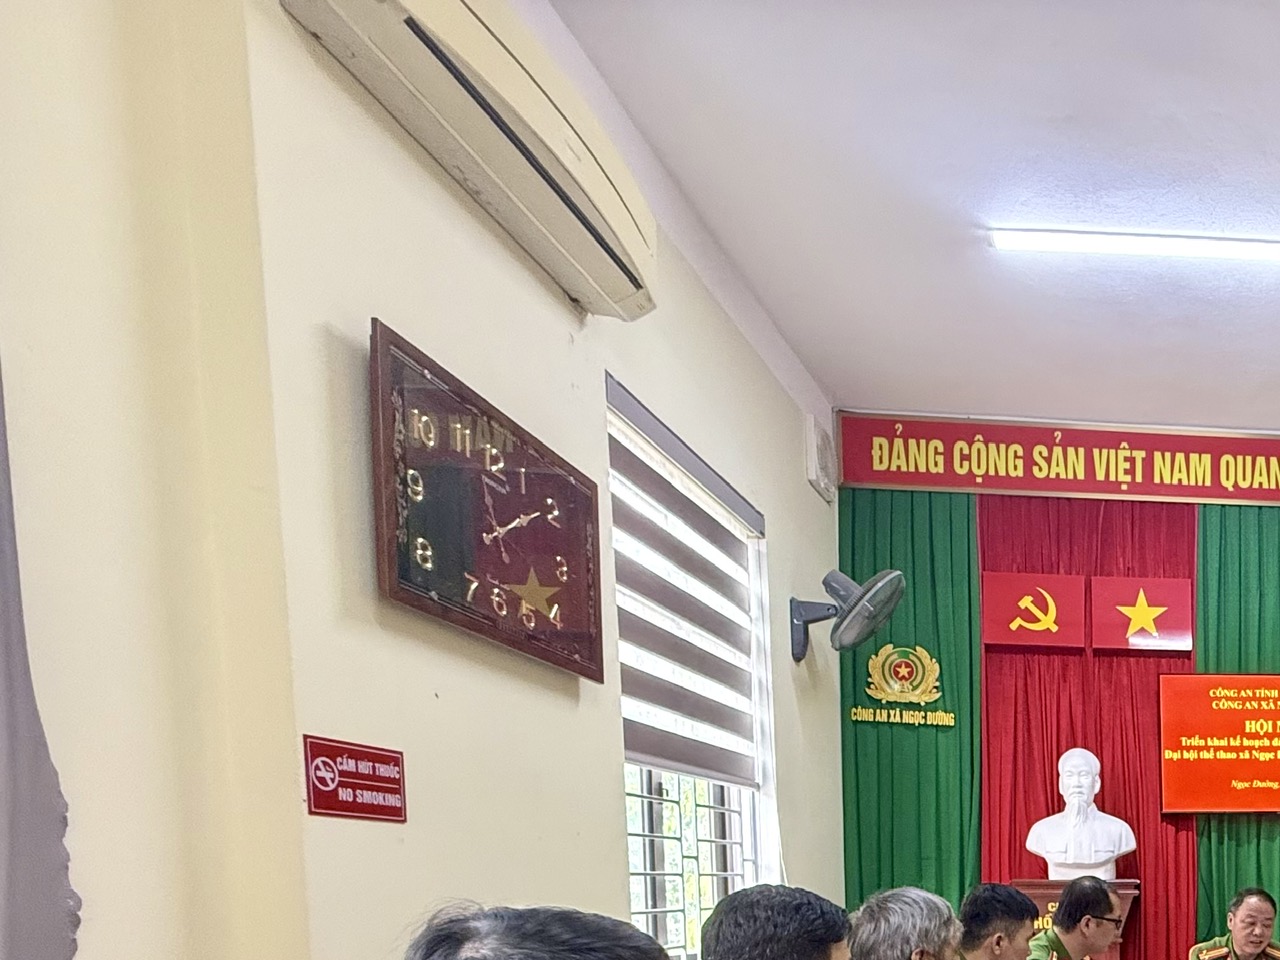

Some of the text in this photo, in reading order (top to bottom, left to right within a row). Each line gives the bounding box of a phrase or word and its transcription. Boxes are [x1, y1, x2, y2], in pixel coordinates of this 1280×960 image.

[872, 423, 944, 474] ĐẢNG
[953, 434, 1024, 483] CỘNG
[1032, 431, 1085, 480] SẢN
[1092, 442, 1146, 490] VIỆT
[1153, 450, 1212, 486] NAM
[1209, 686, 1238, 698] CÔNG
[1239, 689, 1253, 698] AN
[1254, 687, 1279, 698] TỈNH
[1212, 698, 1242, 710] CÔNG
[1244, 701, 1258, 710] AN
[1260, 699, 1275, 710] XÃ
[851, 705, 874, 722] CÔNG
[875, 708, 888, 723] AN
[889, 708, 902, 723] XÃ
[902, 710, 925, 727] NGỌC
[1244, 718, 1273, 736] HỘI
[1180, 735, 1205, 747] Triển
[1207, 737, 1228, 747] khai
[1229, 735, 1242, 747] kế
[1243, 737, 1270, 748] hoạch
[1183, 749, 1198, 761] hội
[1200, 747, 1215, 760] thể
[1216, 749, 1237, 760] thao
[1239, 750, 1250, 760] xã
[1252, 750, 1275, 761] Ngọc
[336, 754, 400, 779] CẤM HÚT THUỐC
[1231, 779, 1251, 790] Ngọc
[338, 787, 401, 807] NO SMOKING
